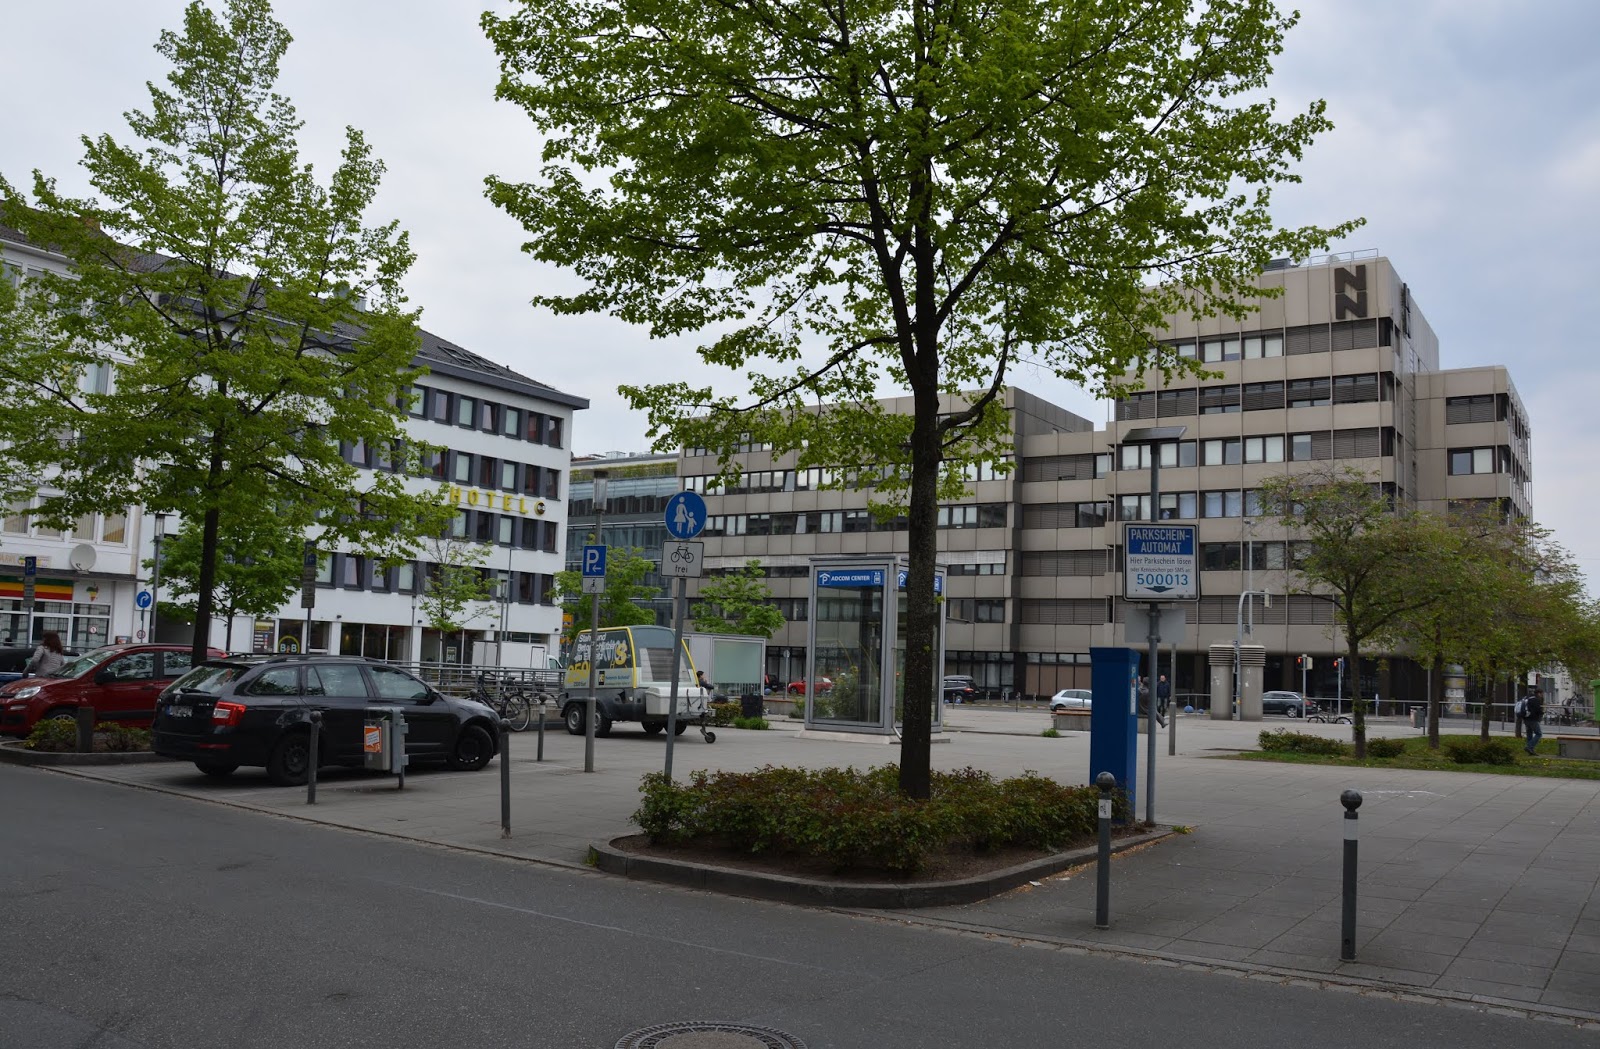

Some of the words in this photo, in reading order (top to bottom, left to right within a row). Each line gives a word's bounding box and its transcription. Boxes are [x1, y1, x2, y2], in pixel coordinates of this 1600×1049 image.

[449, 485, 530, 514] HOTEL
[1130, 528, 1191, 541] PARKSCHEIN-
[1140, 541, 1182, 553] AUTOMAT
[585, 549, 600, 573] P
[1129, 556, 1143, 565] Hier
[1144, 556, 1176, 565] Parkschein
[1176, 556, 1192, 565] lösen
[675, 564, 688, 573] frei
[1136, 573, 1189, 586] 500013
